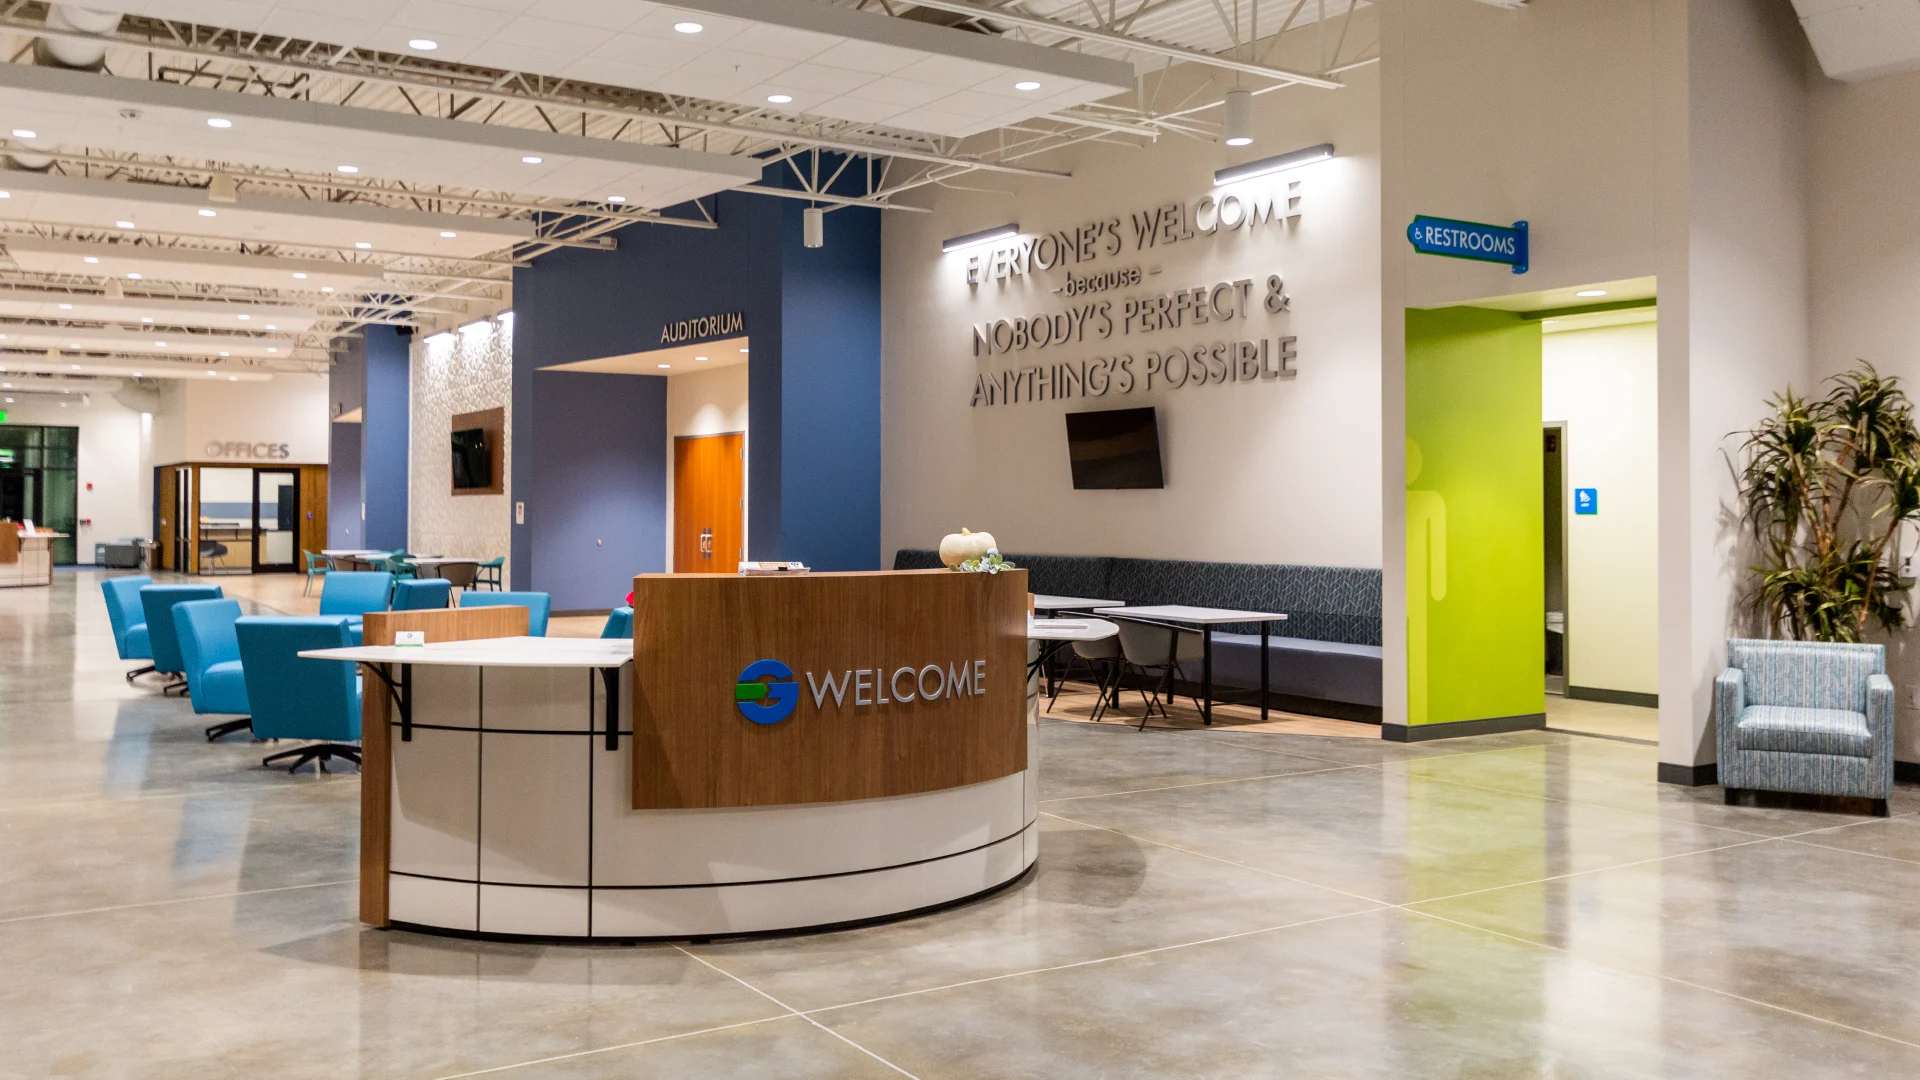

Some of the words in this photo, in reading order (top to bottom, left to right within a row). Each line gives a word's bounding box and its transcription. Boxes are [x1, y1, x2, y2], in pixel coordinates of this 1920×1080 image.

[966, 217, 1122, 286] EVERYONE'S
[1131, 179, 1302, 251] WELCOME
[1425, 226, 1516, 255] RESTROOMS
[660, 311, 744, 344] AUDITORIUM
[972, 300, 1113, 357] NOBODY'S
[1124, 278, 1254, 335] PERFECT
[1263, 274, 1291, 315] &
[969, 354, 1135, 408] ANYTHING'S
[1146, 335, 1298, 391] POSSIBLE
[204, 440, 290, 460] OFFICES
[805, 659, 987, 711] WELCOME
